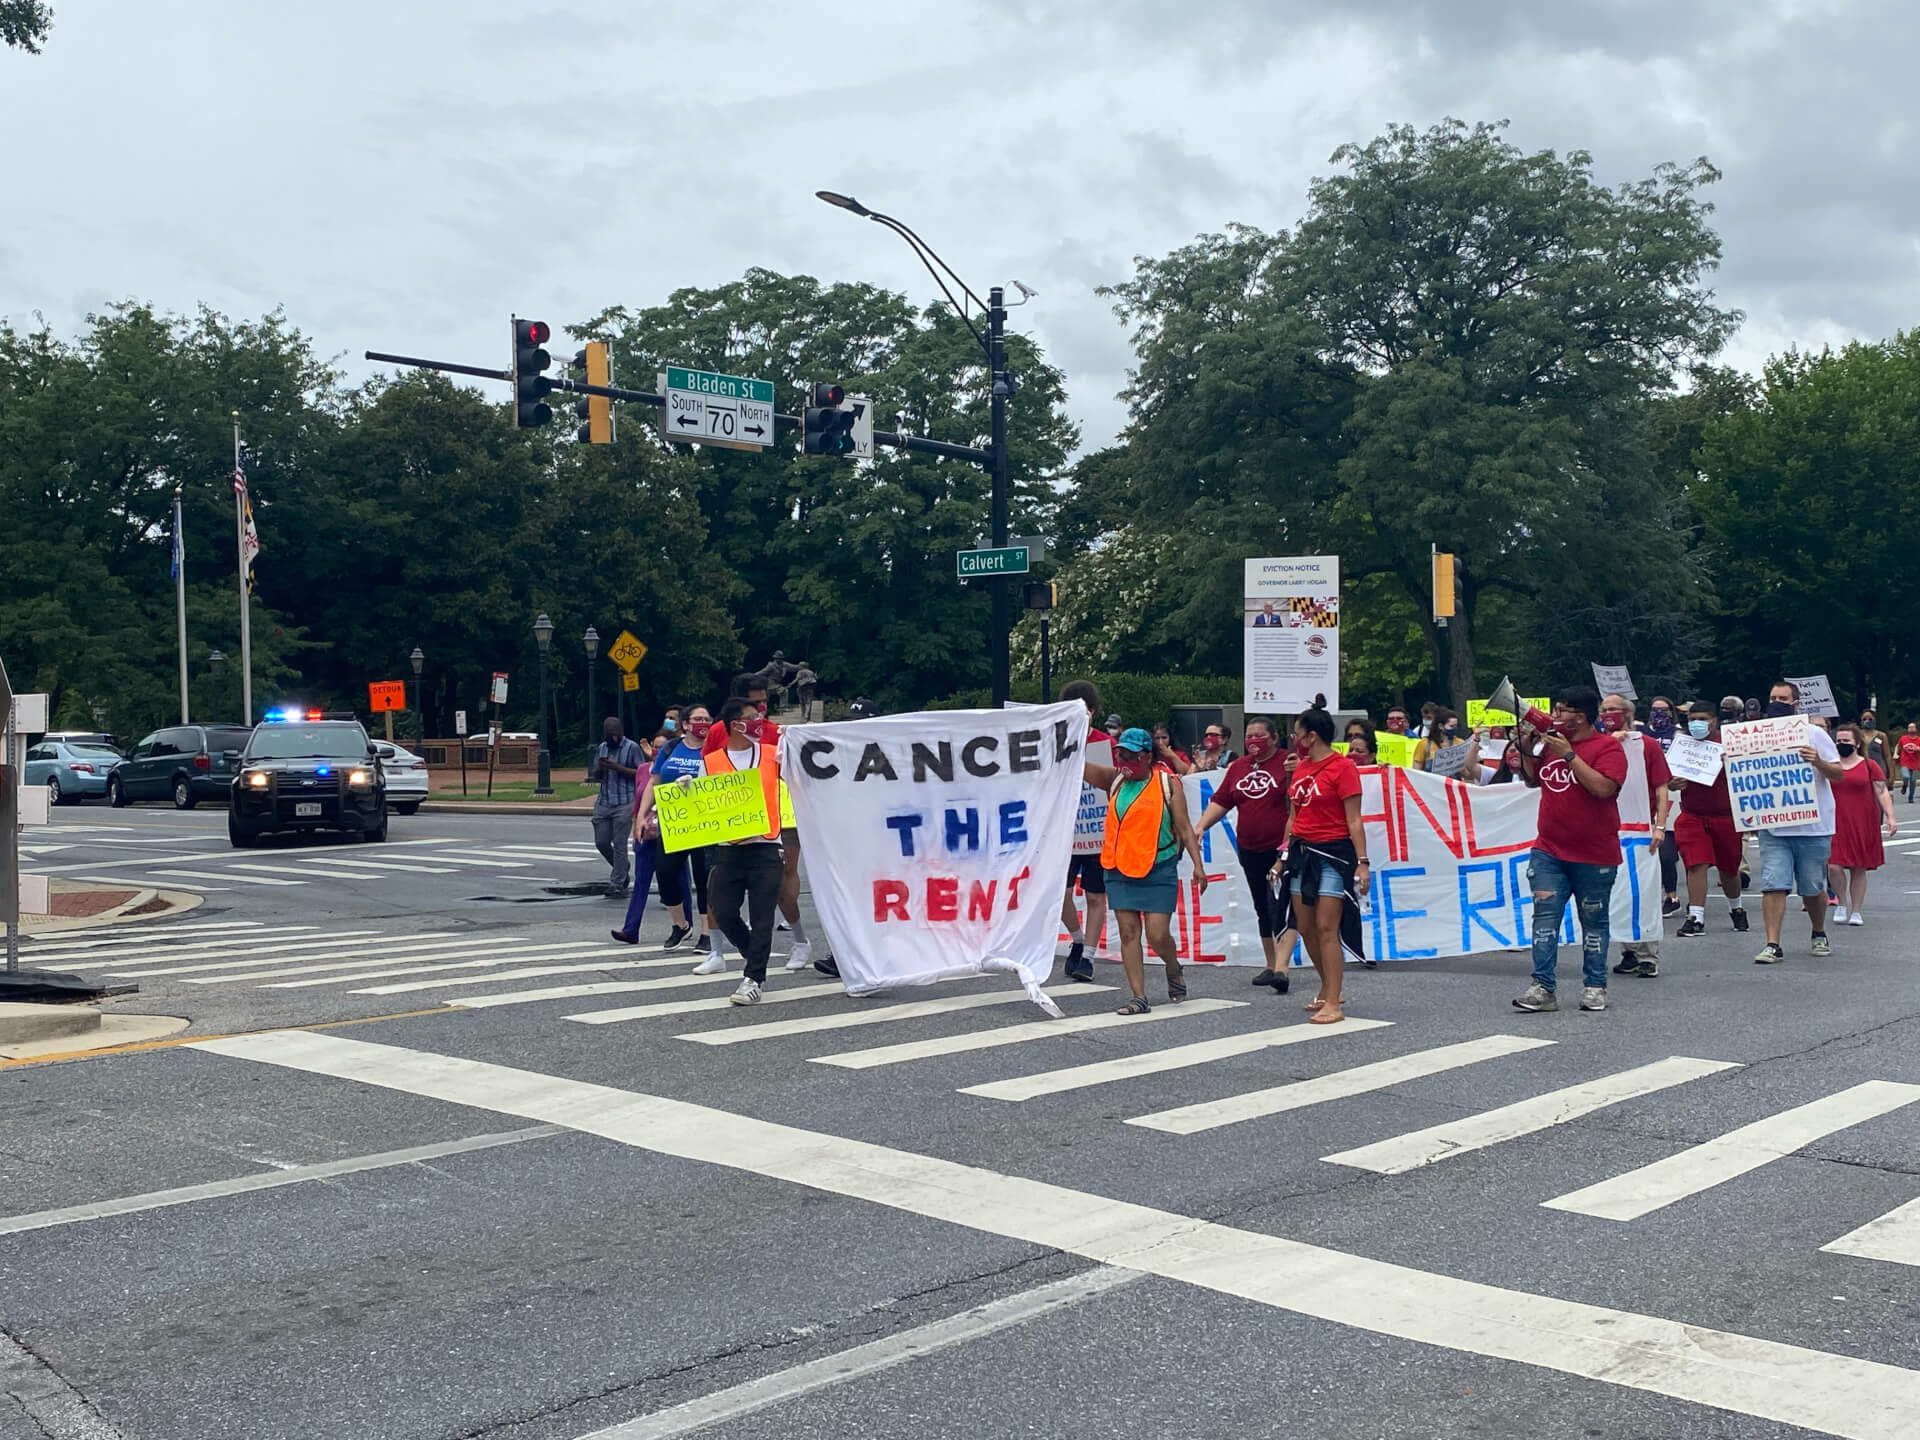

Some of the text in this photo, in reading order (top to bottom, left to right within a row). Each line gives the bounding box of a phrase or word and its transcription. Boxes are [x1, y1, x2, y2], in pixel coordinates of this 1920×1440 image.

[687, 373, 754, 399] Bladen St
[672, 394, 703, 413] SOUTH
[740, 403, 769, 421] NORTH
[708, 411, 734, 435] 70
[961, 551, 1024, 571] Calvert ST
[372, 685, 401, 694] DETOUR
[800, 719, 1079, 783] CANCEL
[1730, 753, 1806, 773] AFFORDABL
[659, 773, 746, 802] GOV HOGAN
[1731, 767, 1814, 793] HOUSING
[661, 806, 689, 823] We
[694, 786, 754, 814] DEMAND
[1738, 788, 1814, 812] FOR ALL
[664, 809, 766, 837] housing relief
[886, 800, 1029, 857] THE
[1761, 810, 1819, 824] REVOLUTION
[872, 865, 1030, 923] RENT
